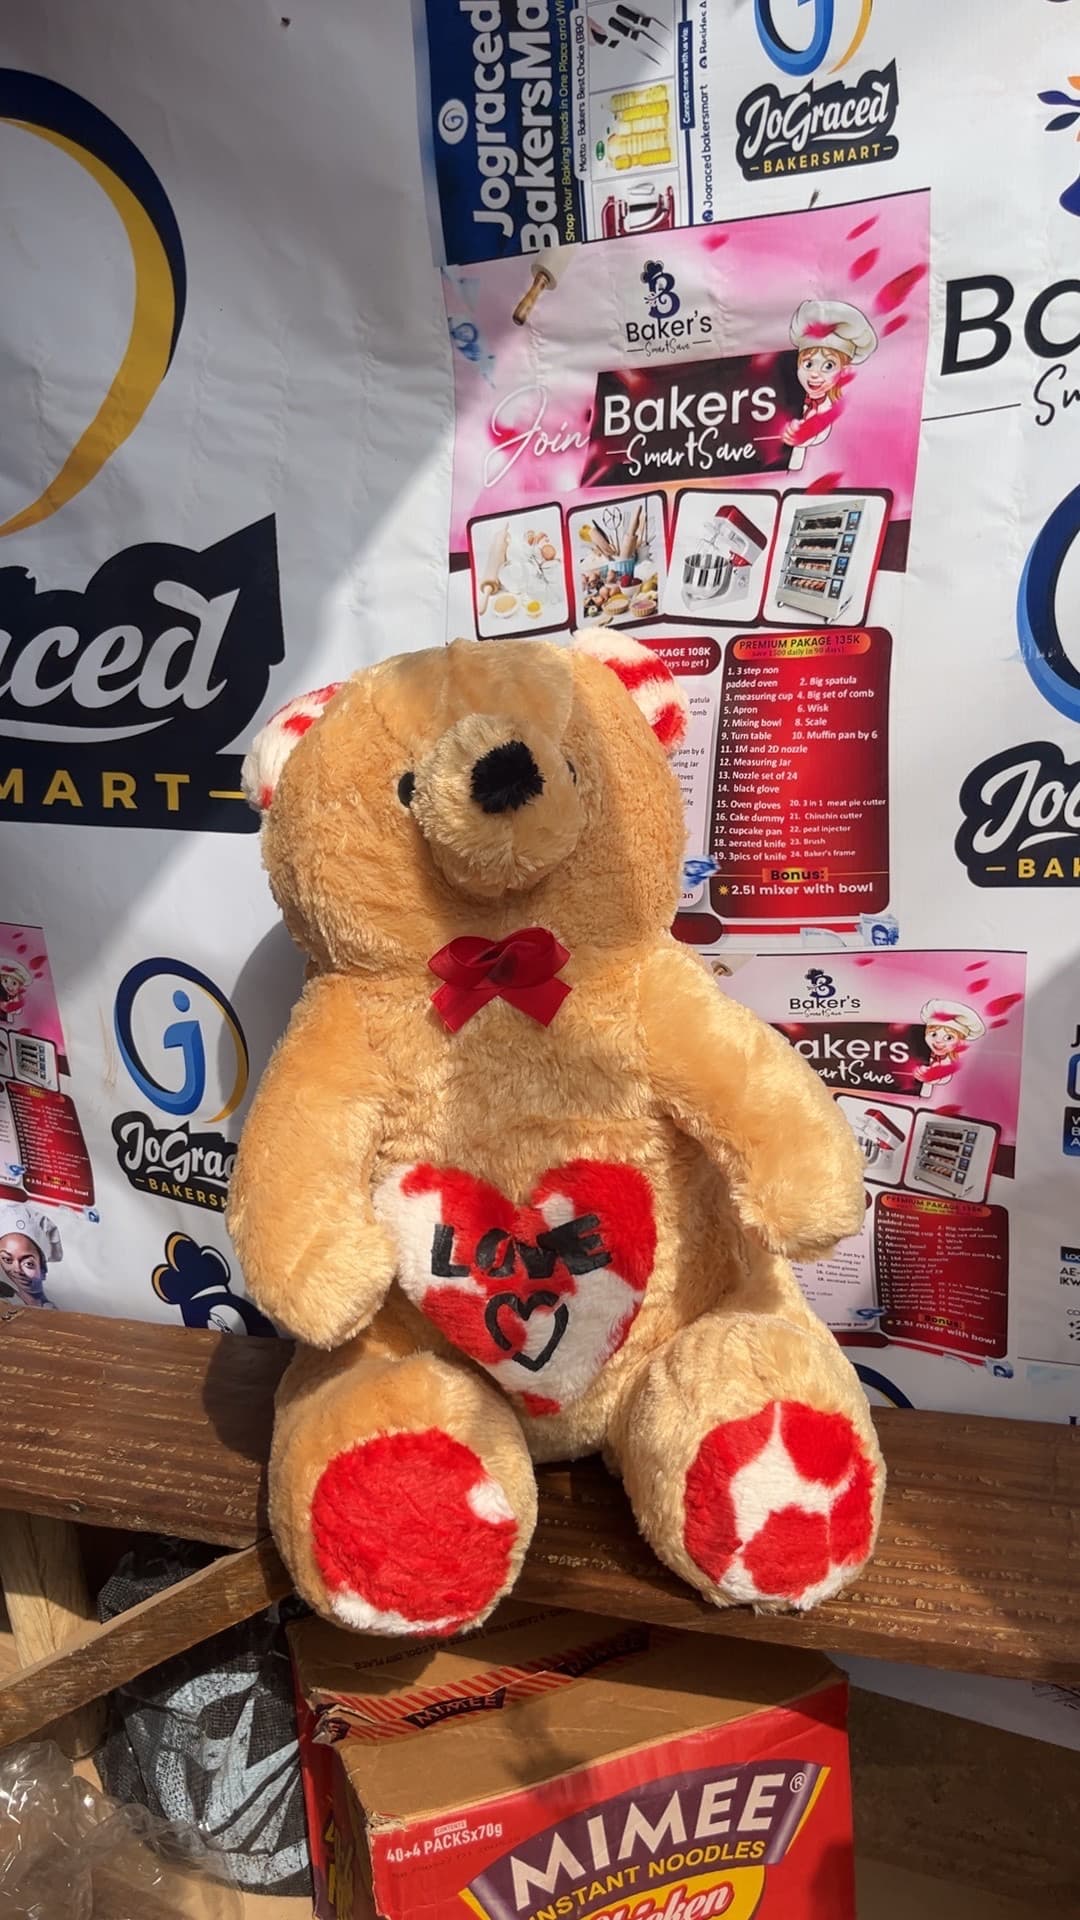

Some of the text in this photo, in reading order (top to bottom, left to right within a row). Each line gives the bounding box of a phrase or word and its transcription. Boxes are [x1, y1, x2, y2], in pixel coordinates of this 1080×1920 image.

[681, 52, 689, 70] with
[574, 16, 587, 172] Motto Bakers Best Choice (BBC)
[682, 91, 691, 124] Connect
[460, 0, 514, 237] Jograced
[699, 84, 711, 152] bakersmart
[743, 82, 890, 159] JoGraced
[556, 17, 576, 241] Shop Your Baking Needs in One Place and
[763, 144, 881, 173] BAKERSMART
[626, 309, 712, 343] Baker's
[603, 385, 777, 437] Bakers
[484, 385, 591, 488] Join
[625, 426, 756, 477] SmartSave
[739, 635, 860, 650] PREMIUM PAKAGE 135K
[688, 647, 711, 656] 108K
[691, 659, 704, 668] get
[727, 667, 735, 676] 1.
[736, 667, 743, 675] 3
[743, 667, 761, 676] step
[726, 680, 778, 690] padded oven
[799, 675, 857, 687] 2. Big spatula
[725, 692, 793, 703] 3. measuring cup
[796, 688, 875, 701] 4. Big set of comb
[724, 705, 758, 715] 5. Apron
[796, 703, 829, 713] 6. Wisk
[722, 718, 782, 729] 7. Mixing bowl
[794, 717, 828, 727] 8. Scale
[721, 731, 772, 741] 9. Turn table
[792, 730, 878, 741] 10. Muffin pan by 6
[721, 744, 808, 753] 11. 1M and 2D nozzle
[719, 758, 792, 768] 12. Measuring Jar
[718, 771, 798, 780] 13. Nozzle set of 24
[717, 784, 780, 795] 14. black glove
[716, 800, 781, 811] 15. Oven gloves
[789, 799, 801, 807] 20.
[802, 799, 808, 807] 3
[809, 799, 817, 807] in
[848, 799, 861, 808] pie
[715, 813, 785, 824] 16. Cake dummy
[804, 812, 838, 820] Chinchin
[714, 826, 783, 837] 17. cupcake pan
[821, 825, 851, 834] injector
[713, 838, 787, 848] 18. aerated knife
[713, 852, 787, 861] 19. 3pics of knife
[771, 868, 825, 880] Bonus:
[759, 884, 799, 895] mixer
[803, 883, 835, 894] with
[838, 882, 873, 893] bowl
[789, 995, 861, 1010] Baker's
[431, 1214, 612, 1279] LOVE
[916, 1321, 945, 1333] mixer
[947, 1328, 969, 1339] with
[971, 1333, 996, 1345] bowl
[415, 1694, 498, 1725] MIMEE
[386, 1842, 421, 1863] 40+4
[423, 1823, 503, 1856] PACKSx70g
[510, 1773, 785, 1911] MIMEE
[528, 1840, 766, 1920] NSTANT NOODLES
